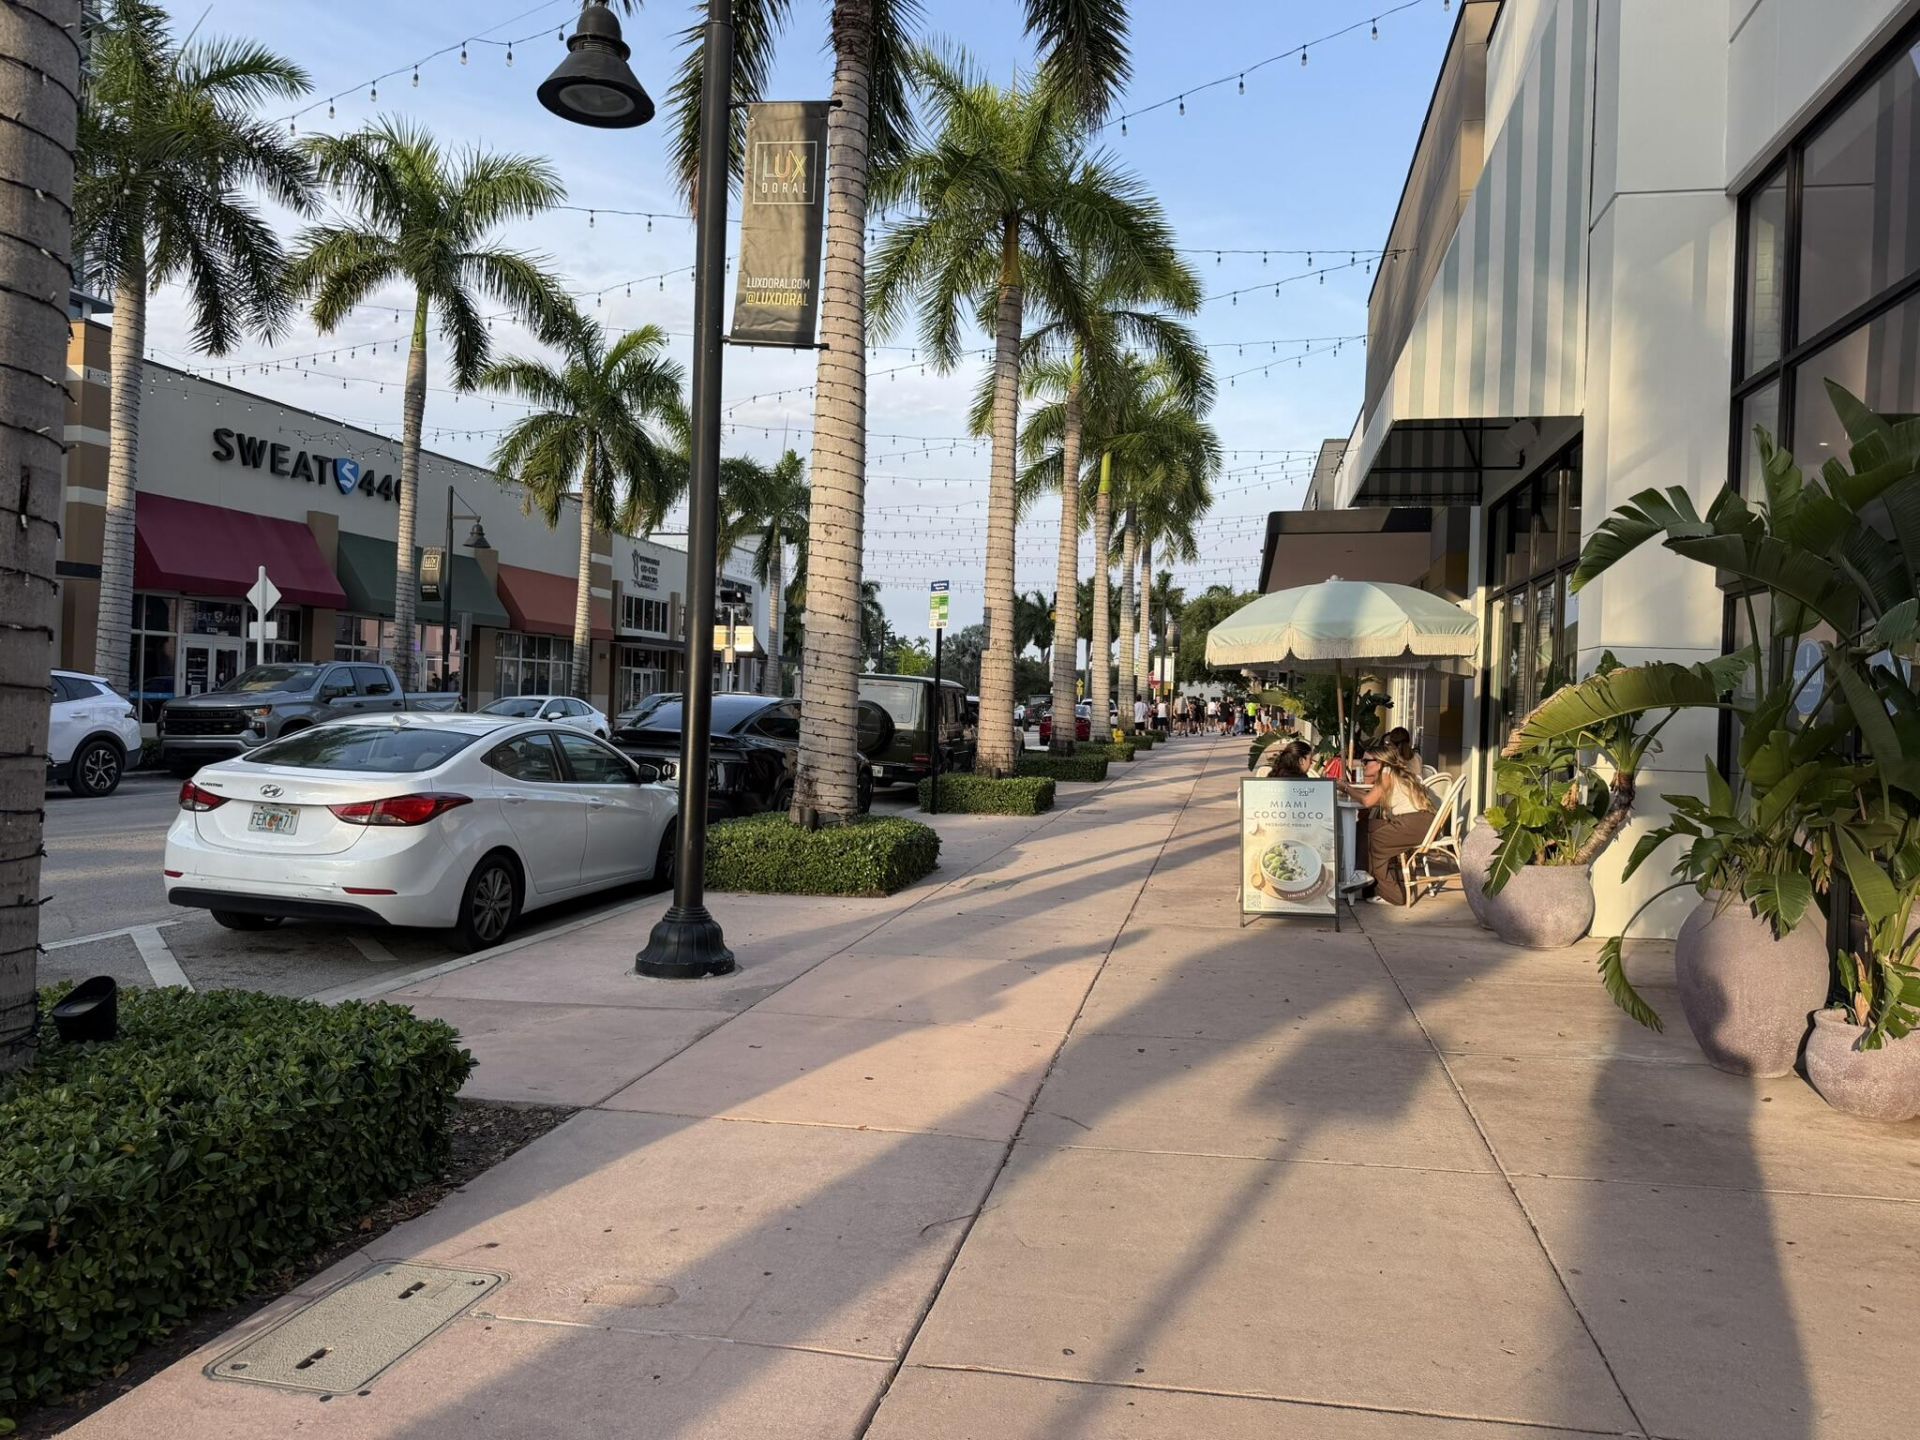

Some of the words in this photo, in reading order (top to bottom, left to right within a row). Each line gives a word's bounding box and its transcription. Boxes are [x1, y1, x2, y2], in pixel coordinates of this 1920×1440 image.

[762, 149, 808, 183] LUX
[761, 182, 808, 194] DORAL
[745, 277, 811, 290] LUXDORAL.COM
[745, 291, 809, 307] @LUXDORAL
[212, 427, 333, 486] SWEAT
[1270, 800, 1307, 808] MIAMI
[1254, 811, 1287, 820] COCO
[1292, 811, 1324, 820] LOCO
